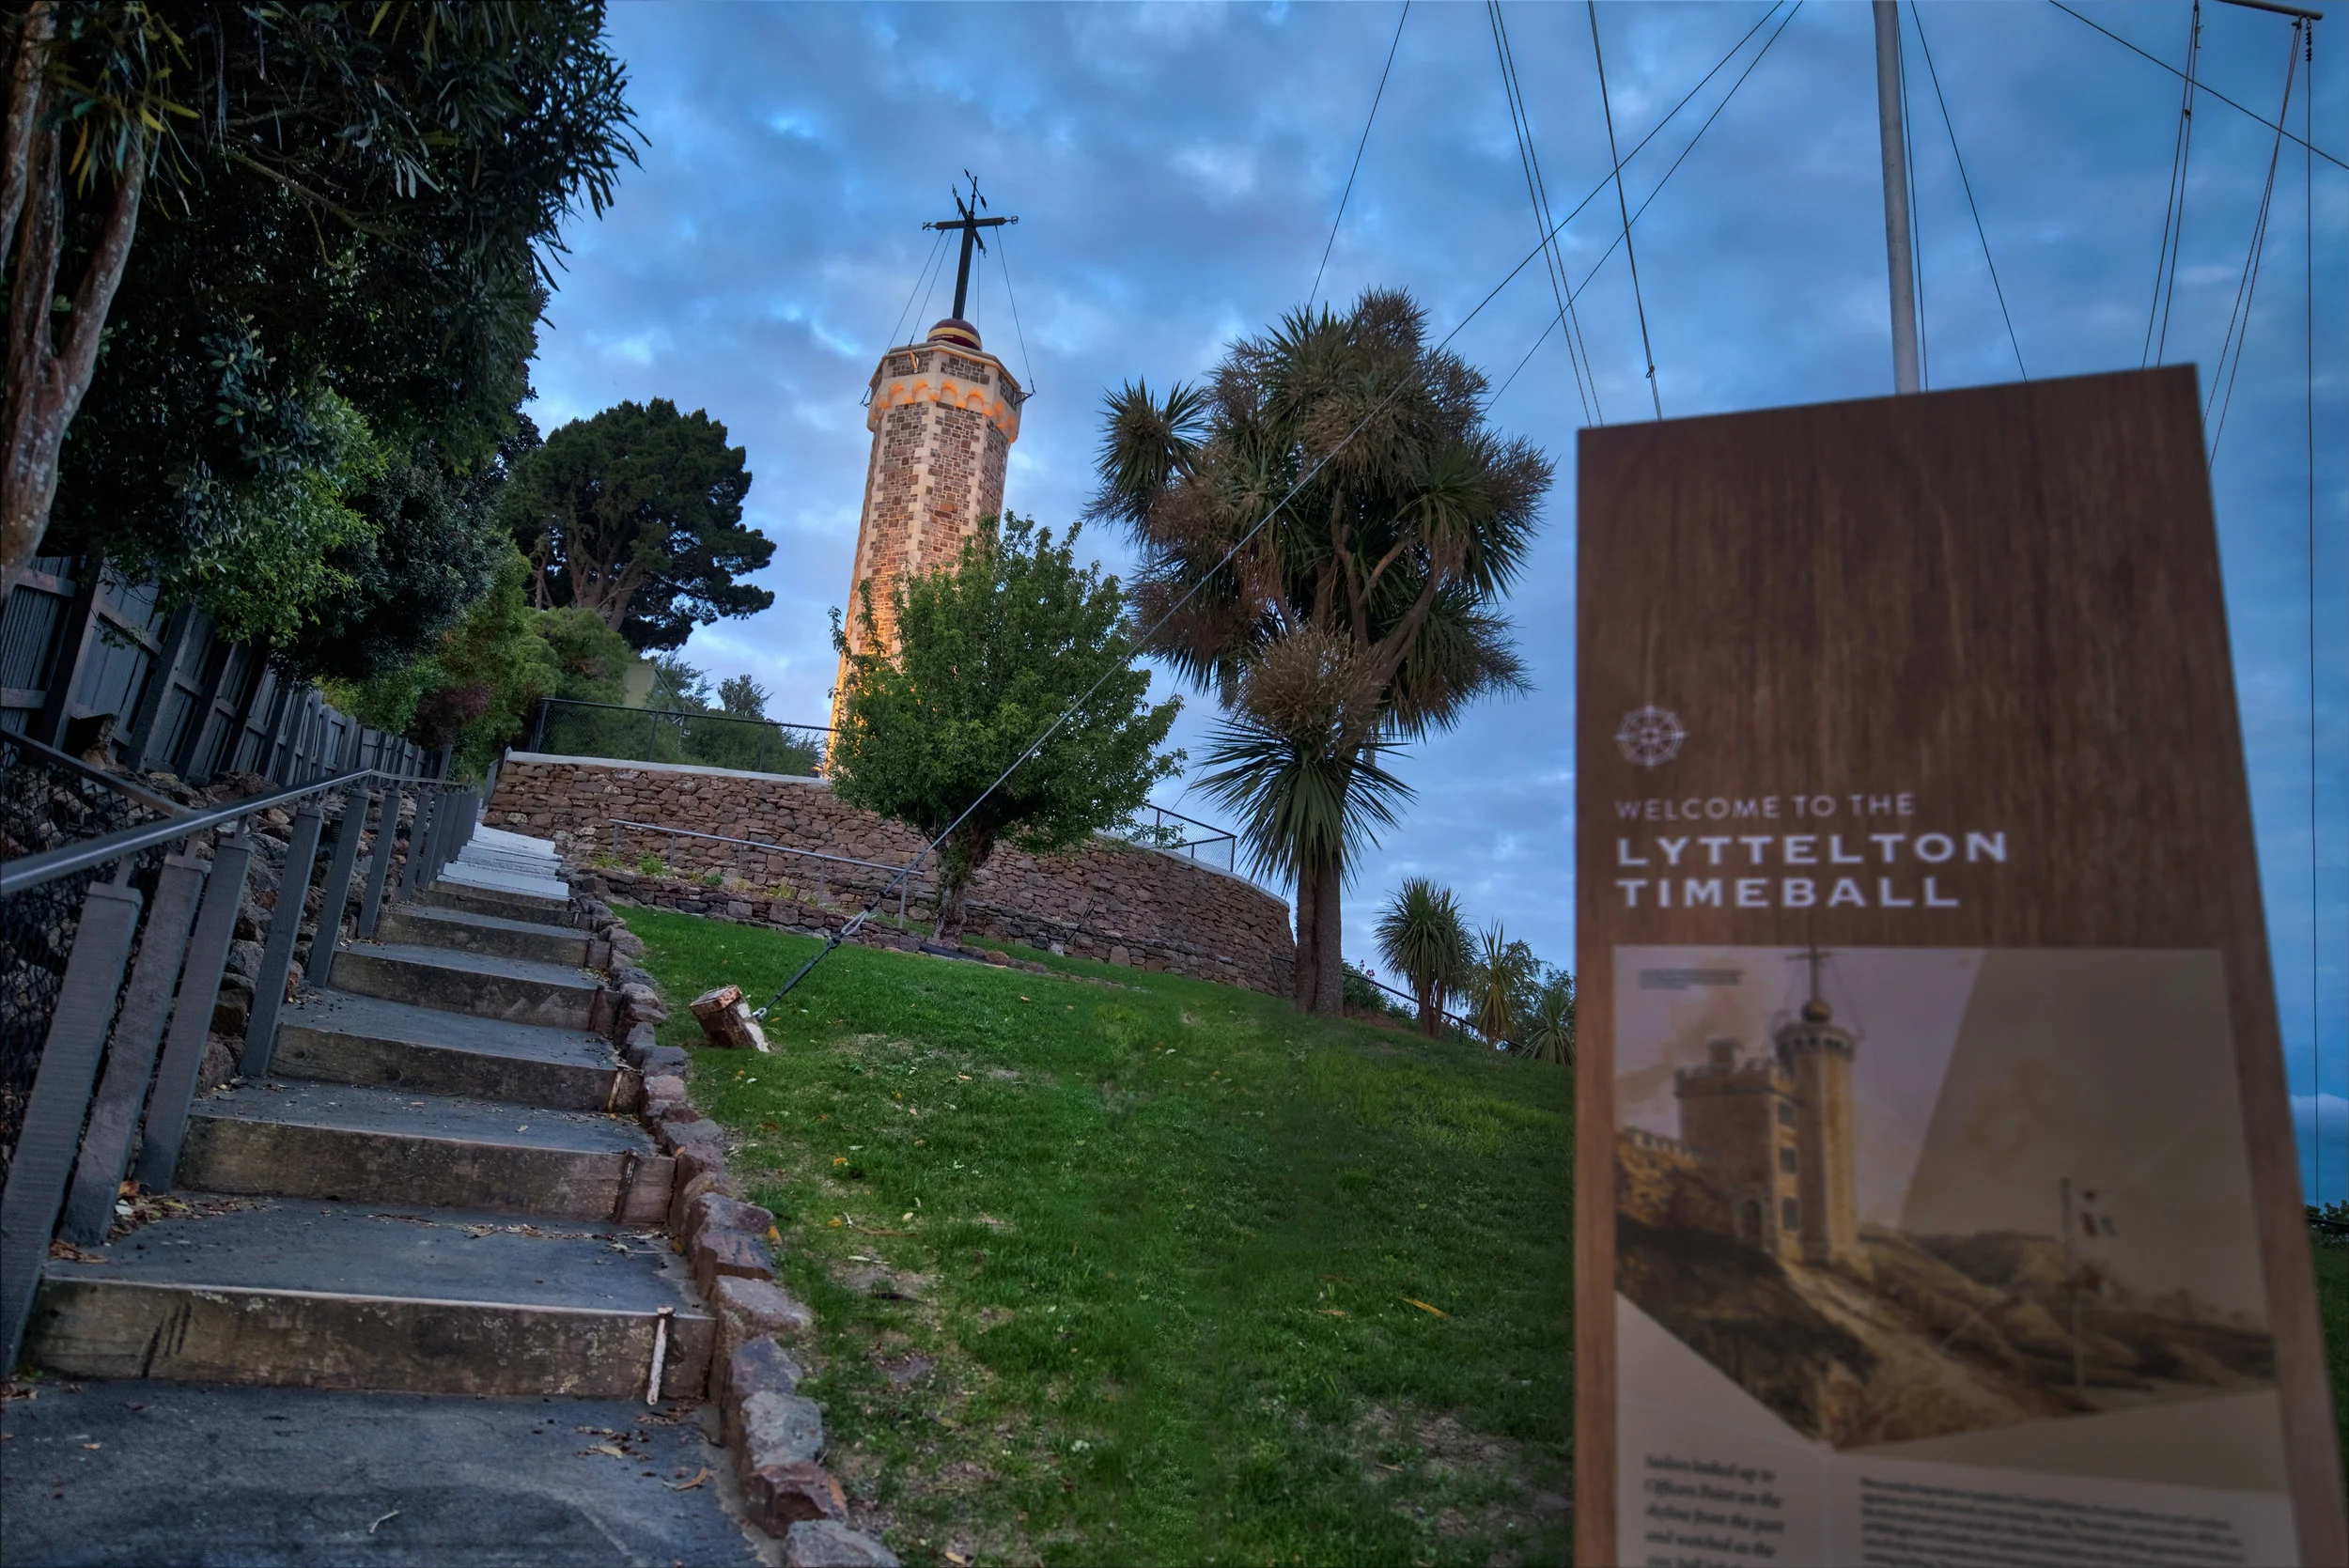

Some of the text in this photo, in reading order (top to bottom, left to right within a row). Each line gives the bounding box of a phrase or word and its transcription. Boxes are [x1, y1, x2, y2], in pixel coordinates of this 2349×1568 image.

[1616, 792, 1914, 821] WELCOME TO THE
[1617, 831, 2008, 866] LYTTELTON
[1616, 877, 1960, 908] TIMEBALL
